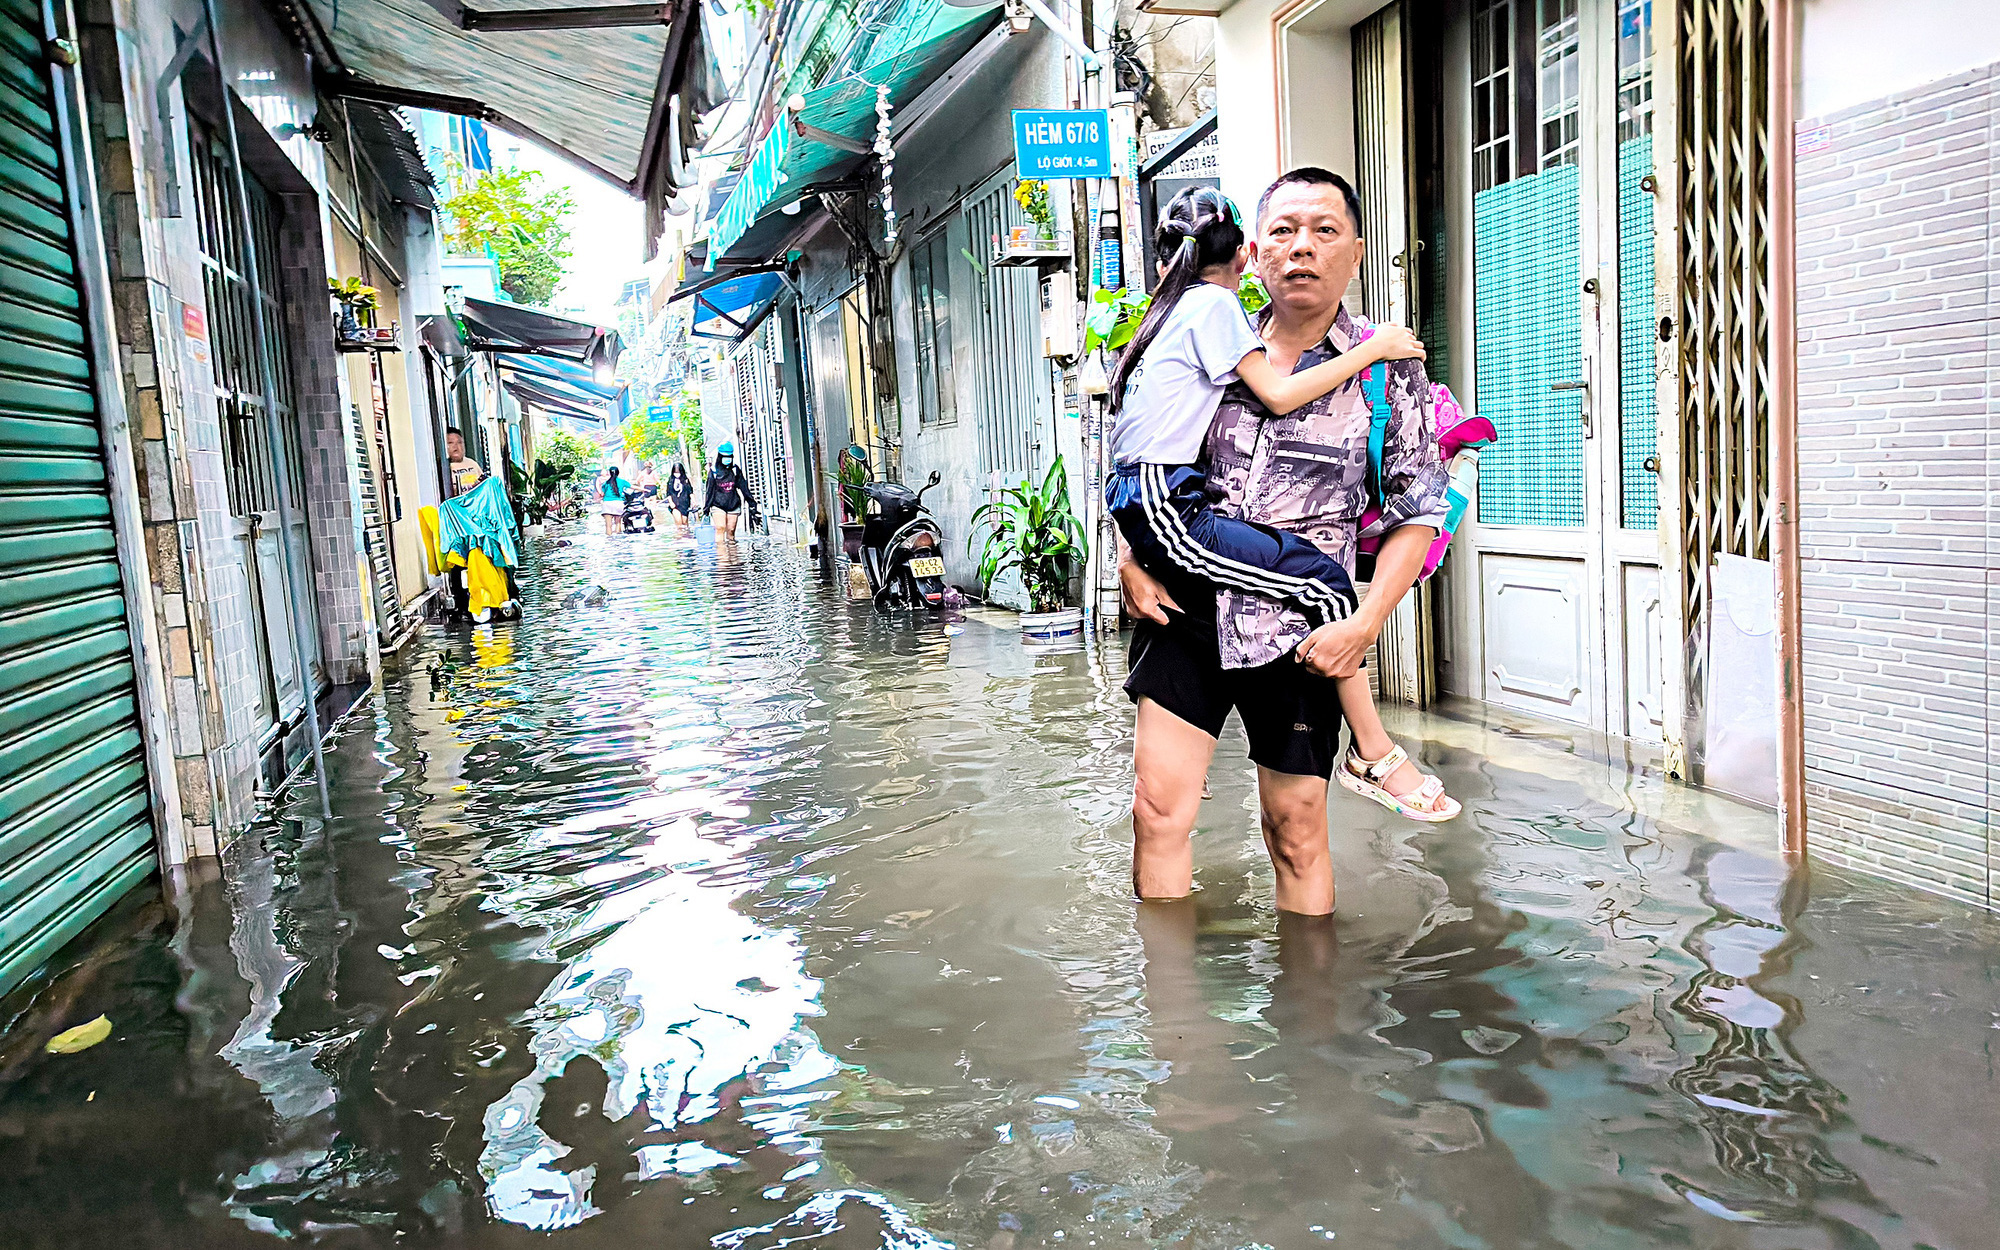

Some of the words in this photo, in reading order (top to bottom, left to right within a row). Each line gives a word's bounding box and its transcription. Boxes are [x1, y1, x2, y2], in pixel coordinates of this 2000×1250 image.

[1025, 116, 1063, 145] HẺM
[1066, 121, 1099, 144] 67/8
[1037, 154, 1051, 171] LỘ
